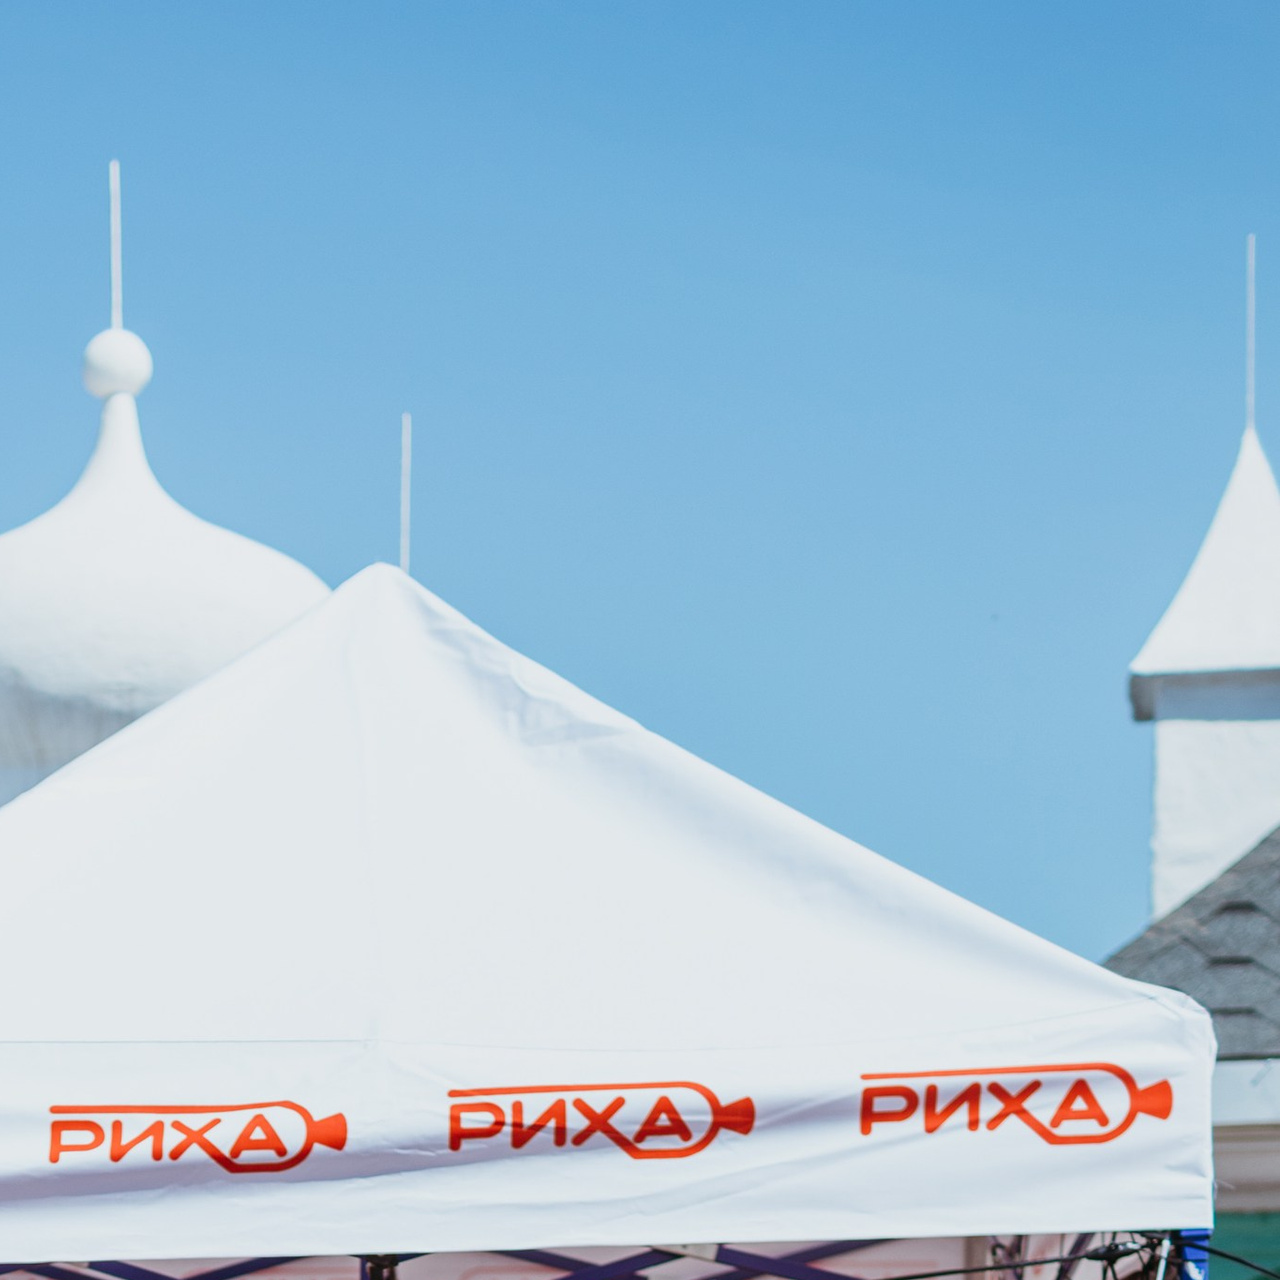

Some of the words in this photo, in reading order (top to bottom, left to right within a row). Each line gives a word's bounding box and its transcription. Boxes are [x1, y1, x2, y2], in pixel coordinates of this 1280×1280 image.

[48, 1106, 295, 1170] РИХА
[448, 1086, 690, 1156] РИХА
[860, 1066, 1120, 1142] РИХА
